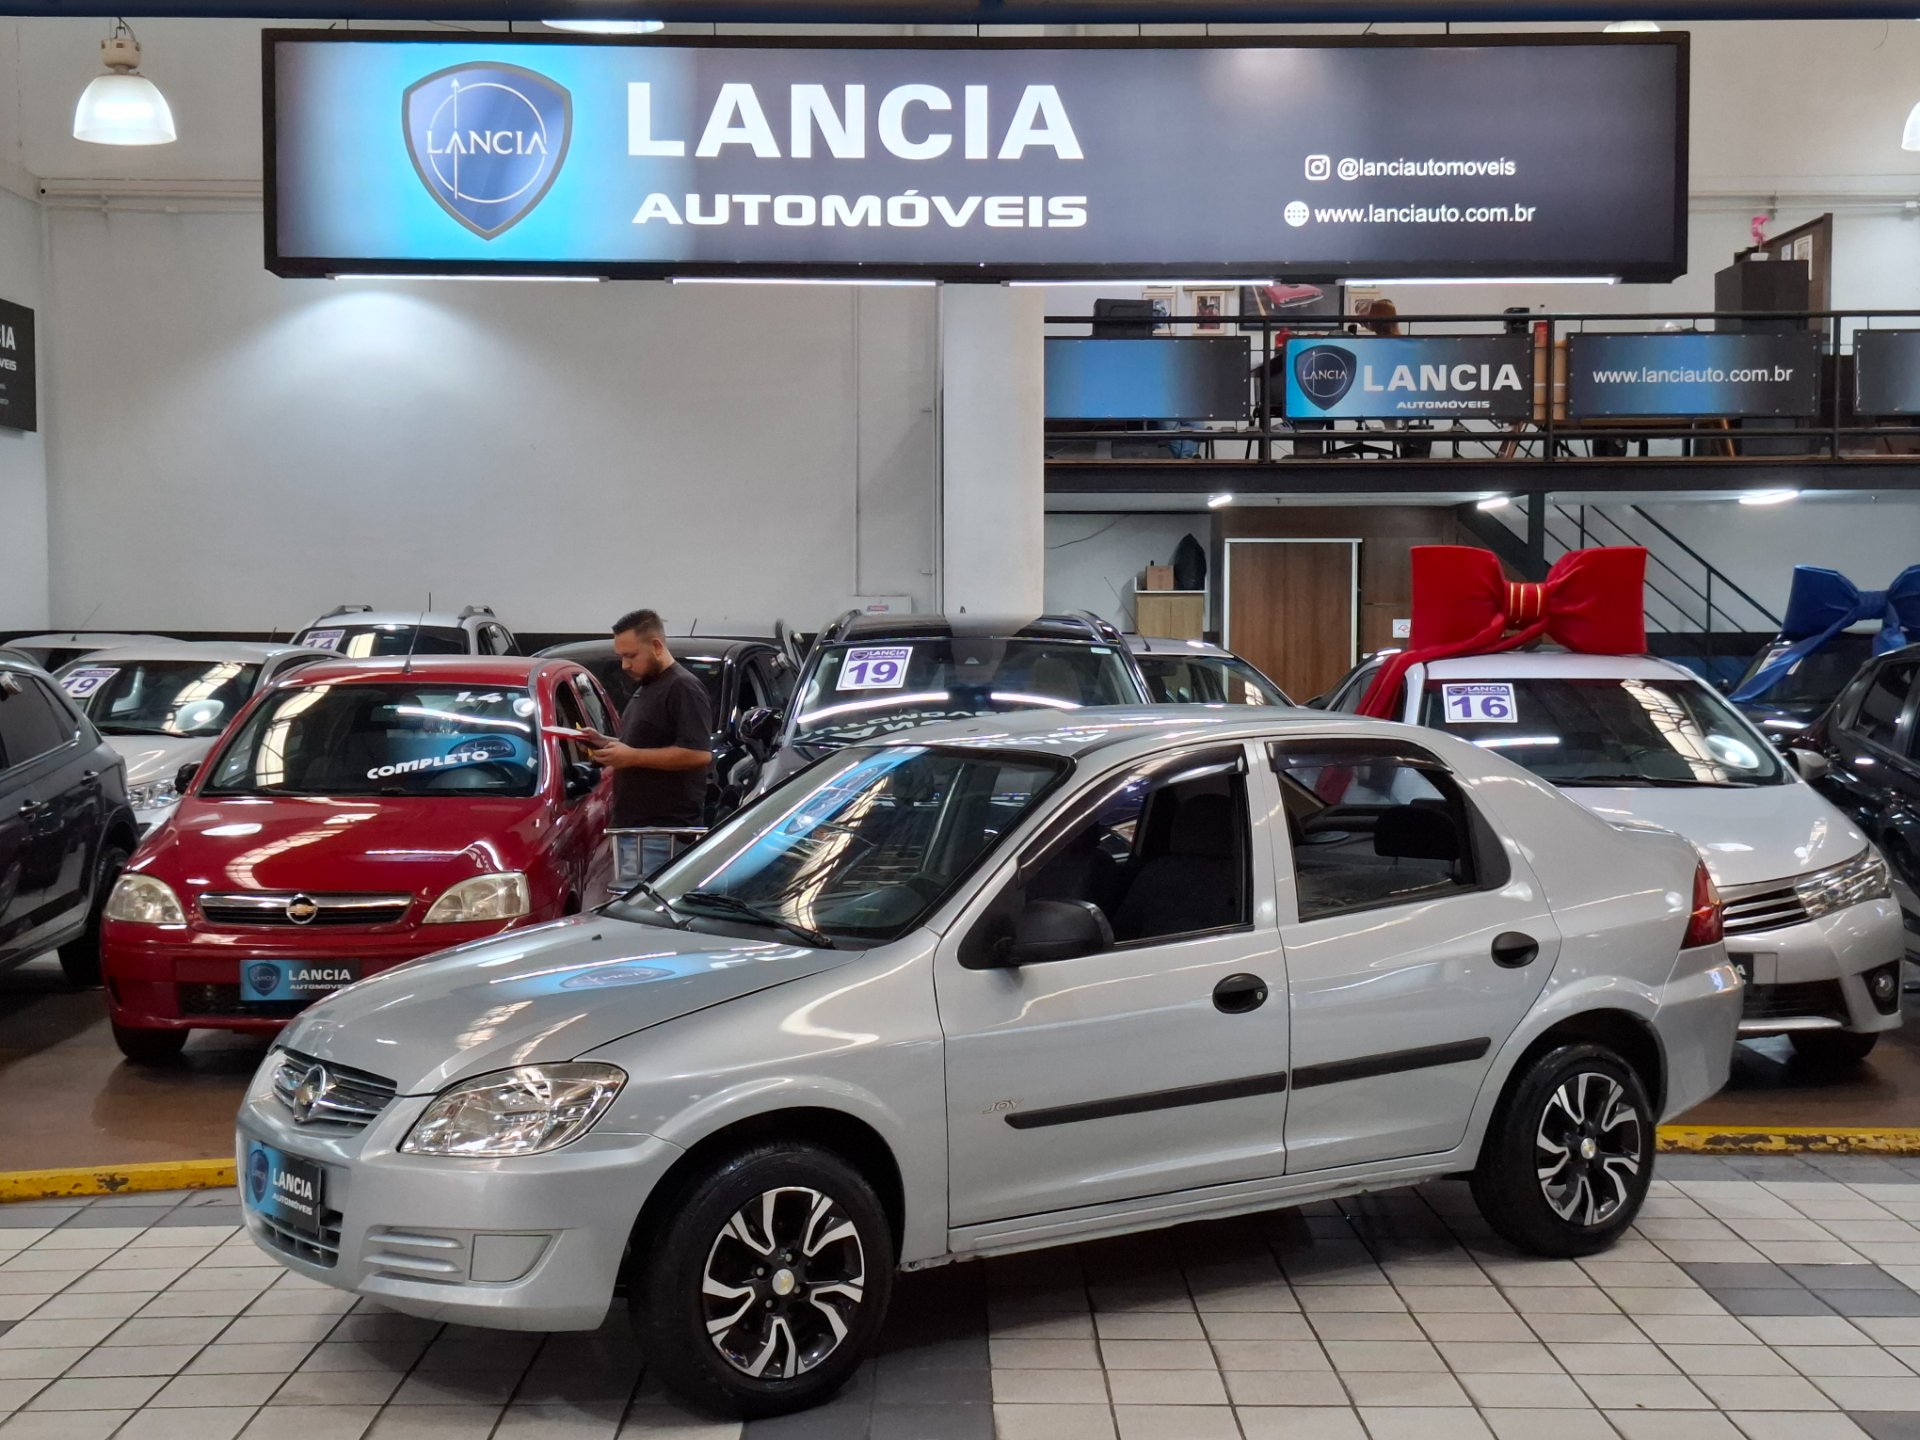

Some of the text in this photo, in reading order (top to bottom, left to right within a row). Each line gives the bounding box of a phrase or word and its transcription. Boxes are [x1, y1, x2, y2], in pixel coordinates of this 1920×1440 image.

[627, 82, 1084, 160] LANCIA
[427, 130, 548, 154] LANCIA
[1337, 157, 1516, 181] @lanciautomoveis
[632, 189, 1087, 228] AUTOMÓVEIS
[1314, 203, 1536, 223] www.lanciauto.com.br
[1302, 369, 1348, 380] LANCIA
[1363, 363, 1523, 391] LANCIA
[1593, 366, 1793, 383] www.lanciauto.com.br
[1396, 400, 1490, 409] AUTOMÓVEIS
[848, 661, 899, 685] 19
[62, 678, 98, 694] 19
[1451, 696, 1509, 718] 16
[366, 750, 489, 779] COMPLETO
[288, 969, 351, 981] LANCIA
[272, 1167, 313, 1200] LANCIA
